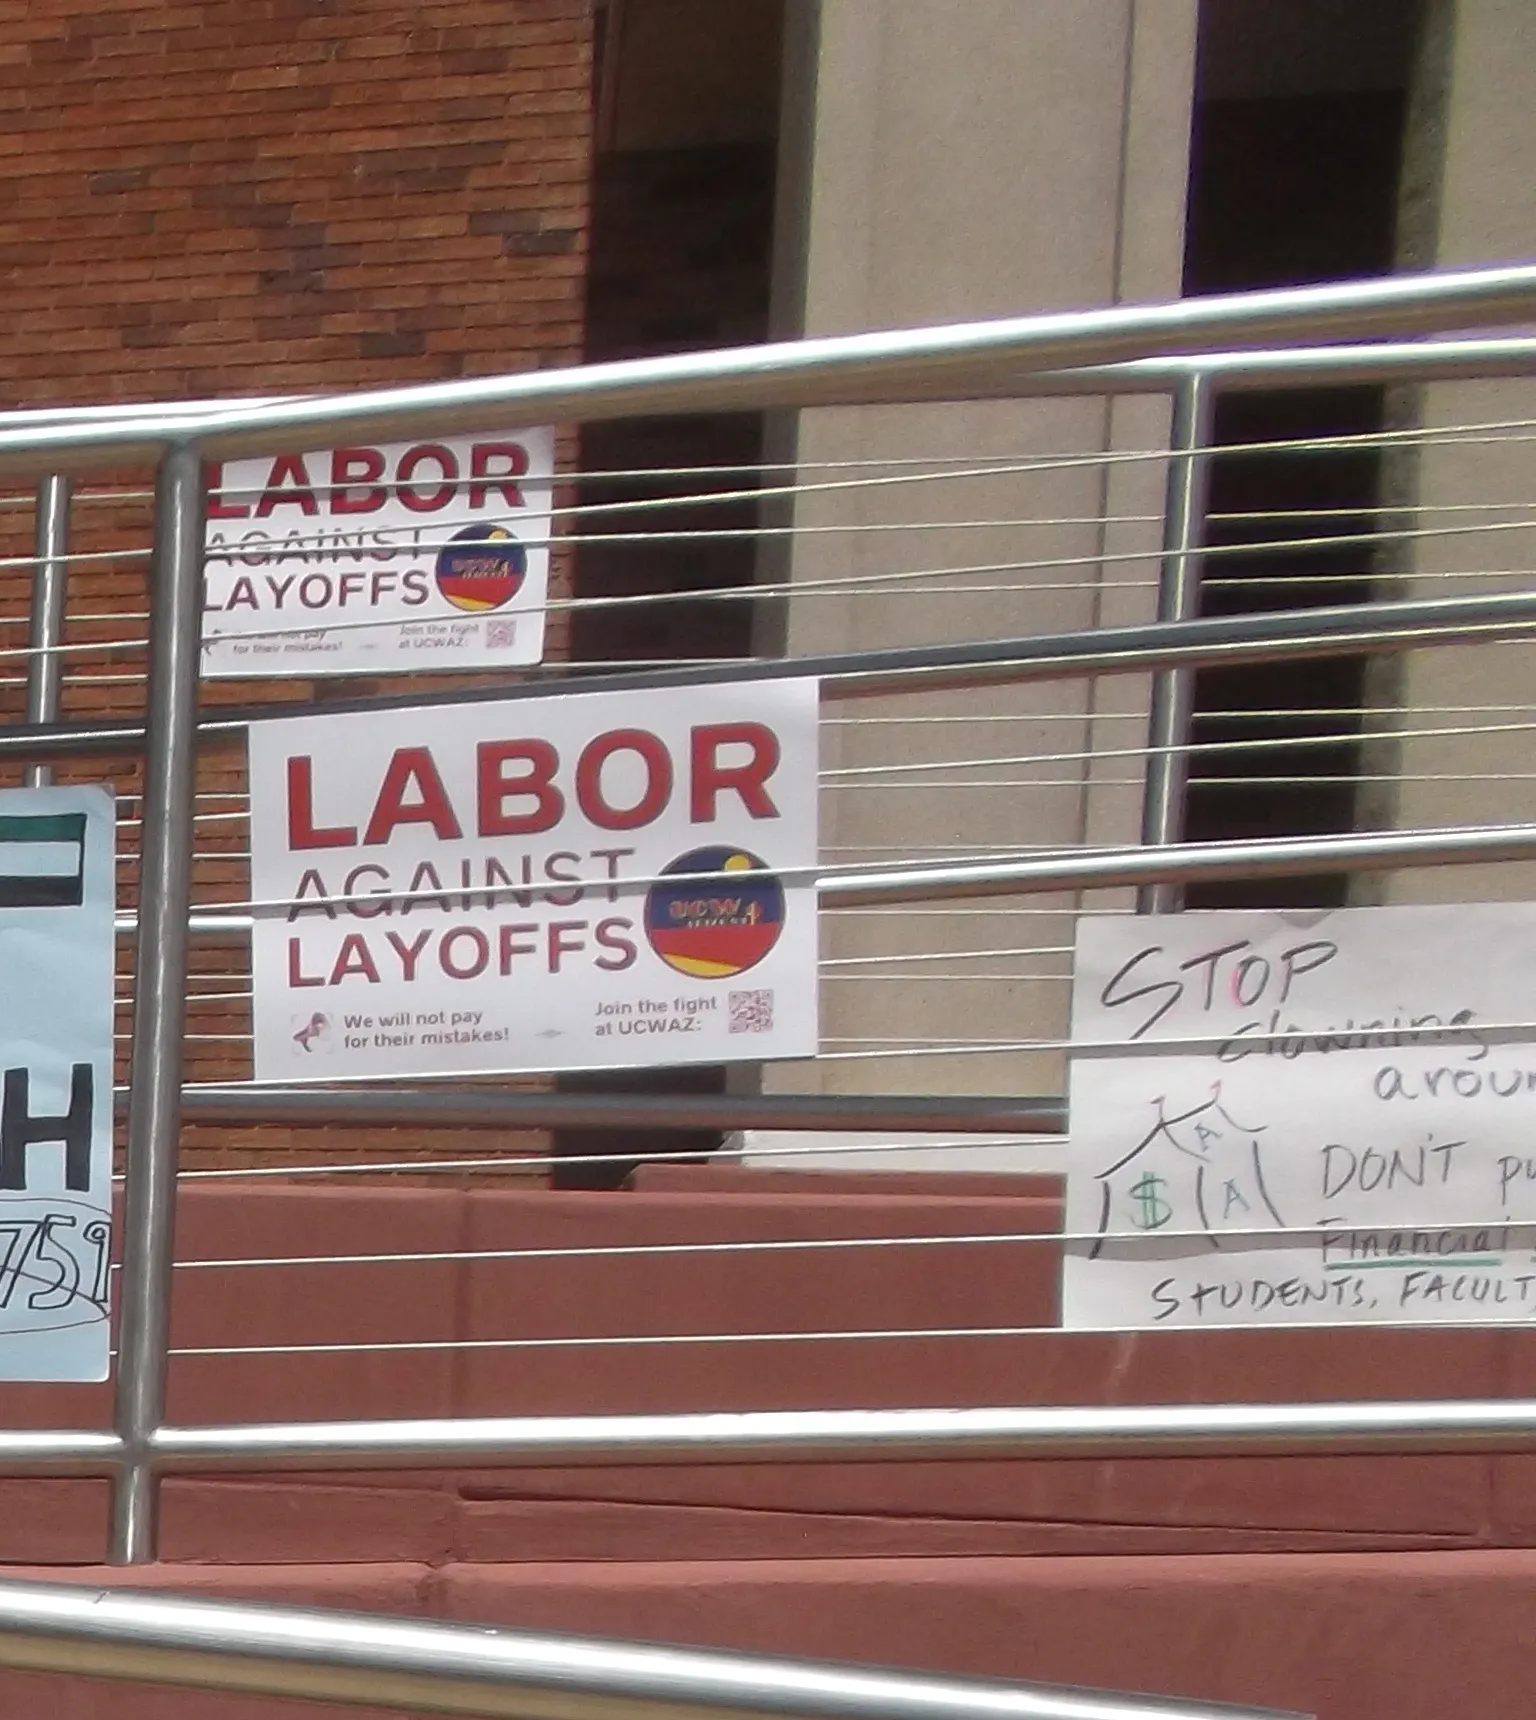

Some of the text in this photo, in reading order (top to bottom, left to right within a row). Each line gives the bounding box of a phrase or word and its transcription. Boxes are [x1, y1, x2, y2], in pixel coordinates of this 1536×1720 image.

[207, 441, 530, 519] LABOR
[286, 720, 782, 851] LABOR
[288, 848, 637, 923] AGAINST
[288, 916, 638, 988] LAYOFFS
[595, 996, 718, 1016] Join the fight
[1100, 940, 1339, 1041] STOP
[344, 1011, 483, 1029] We will not pay
[344, 1027, 510, 1049] for their mistakes!
[595, 1021, 612, 1036] at
[1375, 1064, 1536, 1101] arou
[1400, 1270, 1536, 1315] FACULT
